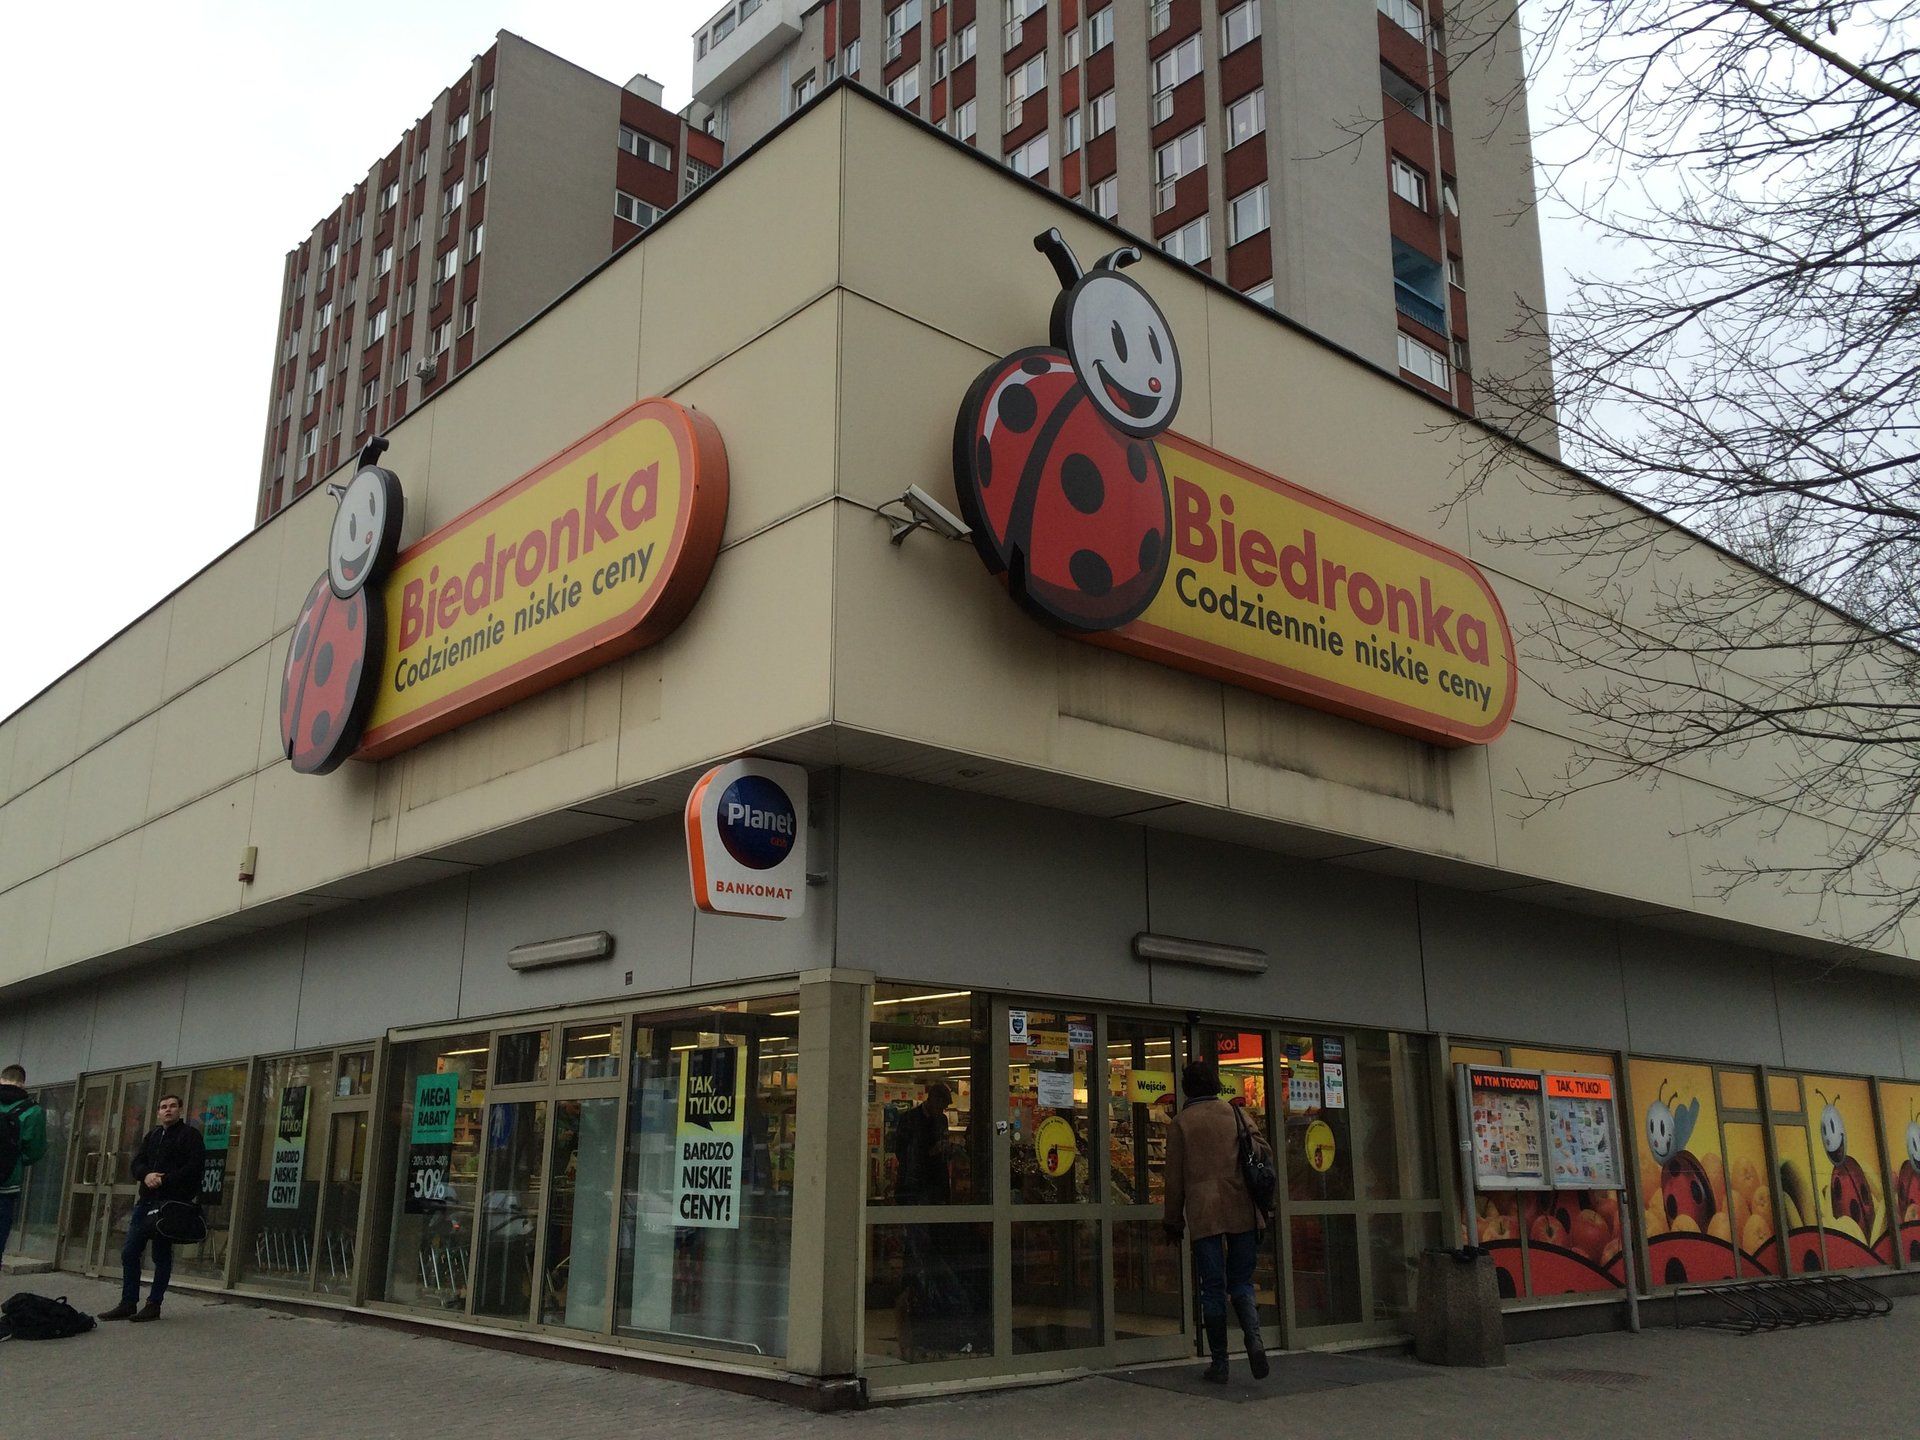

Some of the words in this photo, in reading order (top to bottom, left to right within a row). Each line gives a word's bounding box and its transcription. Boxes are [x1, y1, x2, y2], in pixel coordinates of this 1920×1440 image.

[399, 460, 659, 652] Biedronka
[1173, 475, 1490, 667] Biedronka
[394, 614, 505, 693] Codziennie
[514, 581, 582, 635] niskie
[592, 543, 655, 596] ceny
[1175, 567, 1344, 656] Codziennie
[1355, 634, 1429, 685] niskie
[1439, 669, 1491, 711] ceny
[727, 802, 793, 836] Planet
[716, 880, 793, 900] BANKOMAT
[689, 1076, 717, 1096] TAK,
[1137, 1080, 1167, 1093] Wejście
[1474, 1075, 1483, 1086] W
[1483, 1075, 1500, 1087] TYM
[1500, 1077, 1539, 1091] TYGODNIU
[1556, 1080, 1574, 1094] TAK,
[1575, 1081, 1602, 1095] TYLKO!
[419, 1087, 451, 1107] MEGA
[689, 1096, 733, 1116] TYLKO!
[417, 1109, 451, 1127] RABATY
[276, 1150, 300, 1164] BARDZO
[683, 1142, 734, 1161] BARDZO
[274, 1166, 298, 1183] NISKIE
[410, 1168, 445, 1200] -50%
[682, 1166, 733, 1190] NISKIE
[272, 1185, 296, 1204] CENY!
[679, 1194, 731, 1222] CENY!
